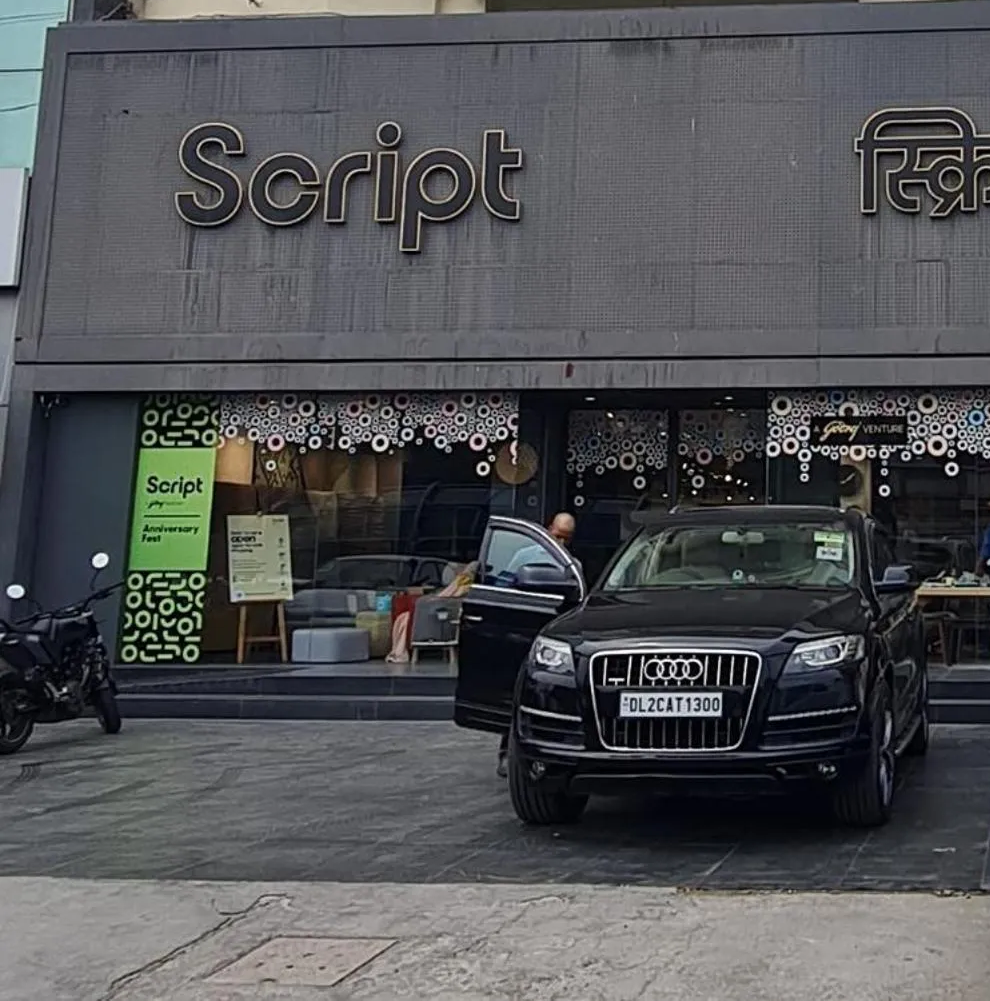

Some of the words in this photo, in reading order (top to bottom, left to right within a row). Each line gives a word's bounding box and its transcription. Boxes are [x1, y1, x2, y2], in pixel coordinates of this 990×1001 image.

[174, 120, 524, 253] Script
[863, 423, 904, 433] VENTURE
[146, 475, 203, 499] Script
[142, 524, 199, 535] Anniversary
[141, 534, 161, 543] Fest
[629, 696, 720, 713] DL2CAT1300
